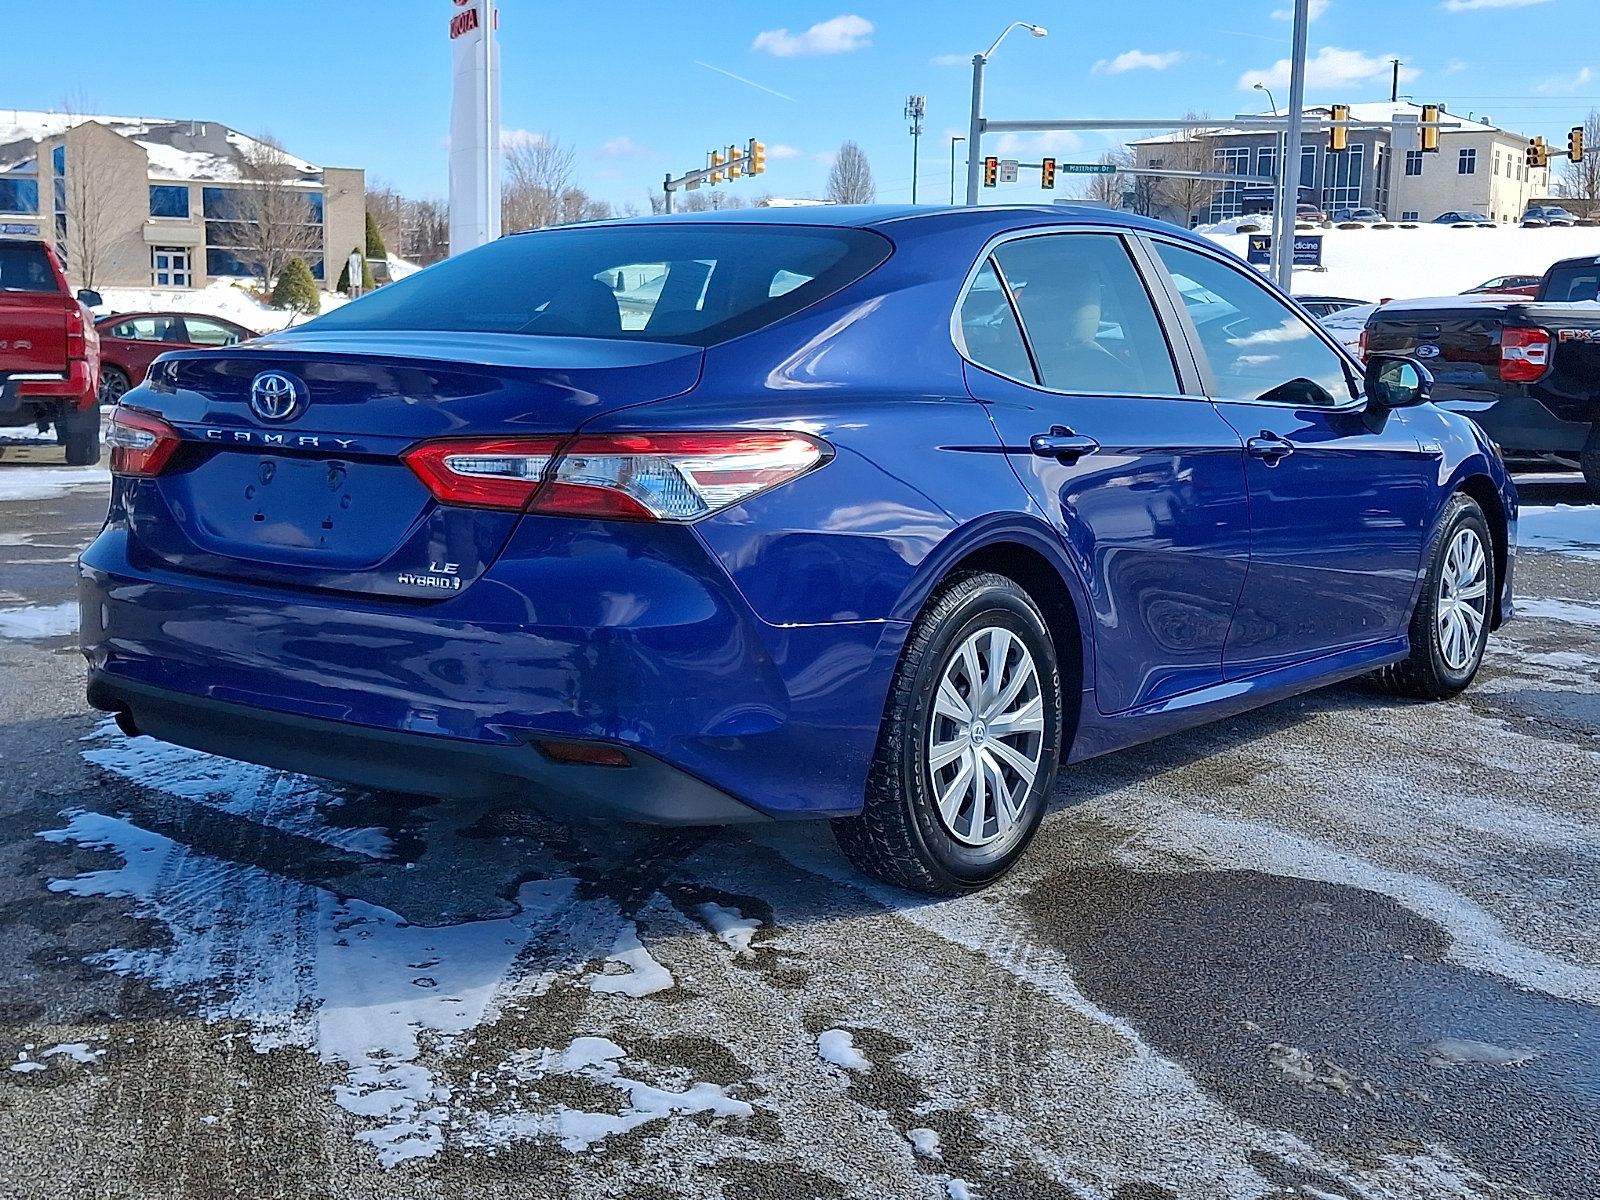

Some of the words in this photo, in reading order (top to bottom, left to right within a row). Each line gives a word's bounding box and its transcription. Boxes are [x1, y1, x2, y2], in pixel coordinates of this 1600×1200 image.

[207, 429, 358, 448] CAMRY
[429, 561, 459, 574] LE
[398, 573, 450, 589] HYBRID
[1052, 664, 1062, 760] YOKOHAMA
